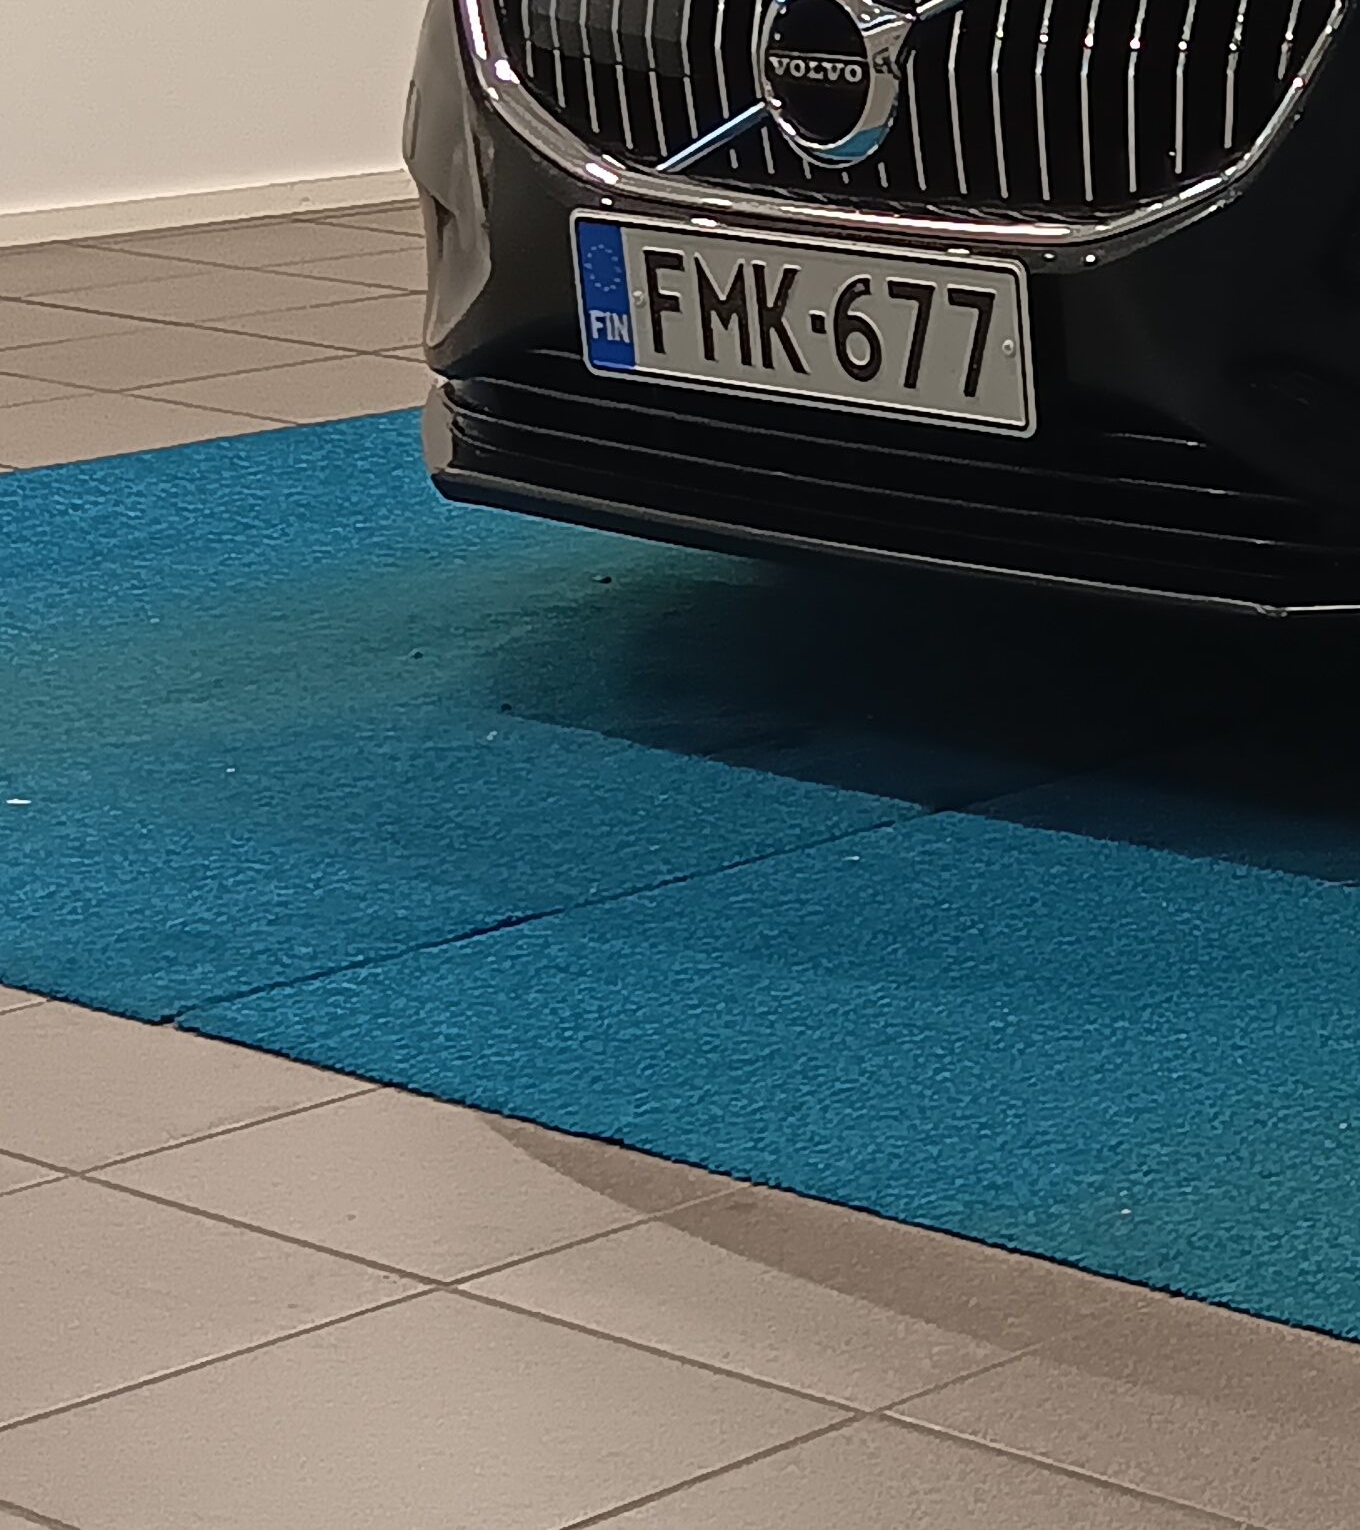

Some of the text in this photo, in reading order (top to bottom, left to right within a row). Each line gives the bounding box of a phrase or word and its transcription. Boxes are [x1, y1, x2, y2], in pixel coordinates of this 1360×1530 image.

[769, 56, 863, 83] VOLVO
[589, 310, 630, 344] FIN
[643, 248, 996, 398] FMK-677
